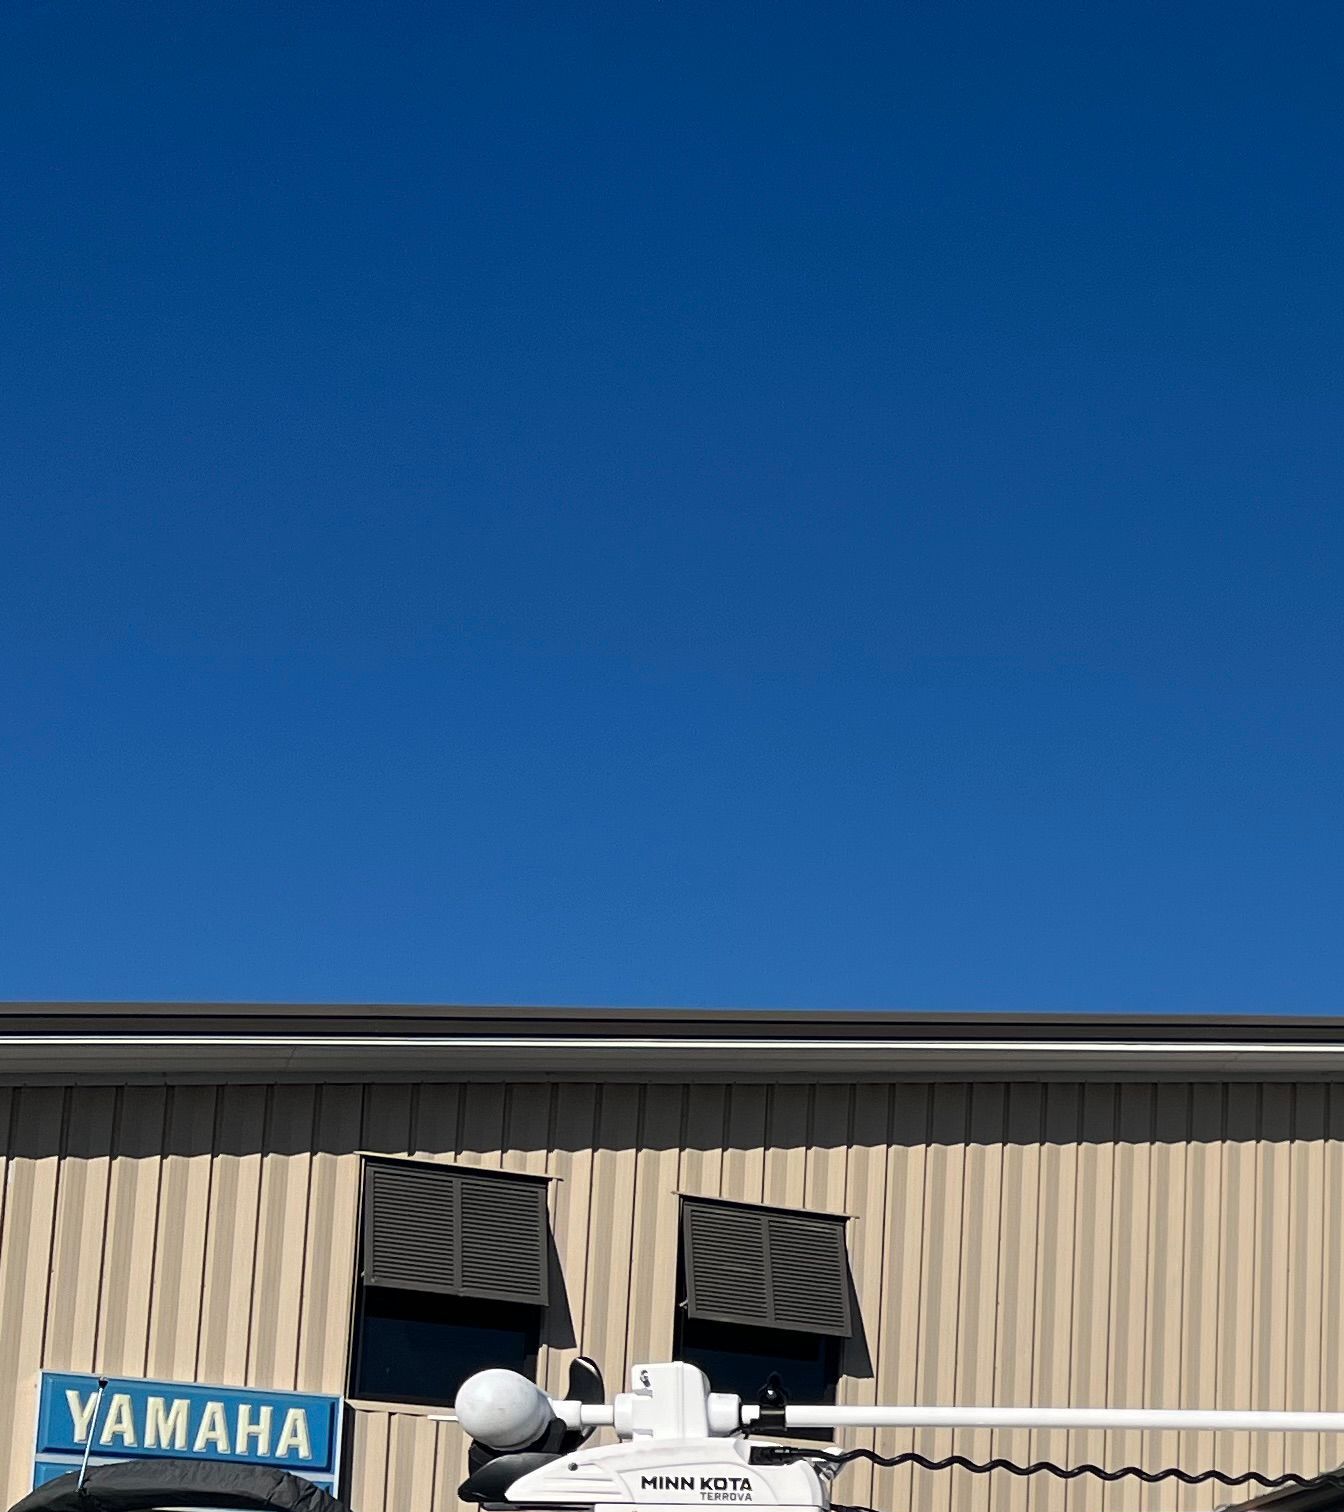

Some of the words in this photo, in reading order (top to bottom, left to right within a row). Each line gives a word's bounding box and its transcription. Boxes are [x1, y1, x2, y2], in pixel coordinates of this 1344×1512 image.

[65, 1389, 313, 1460] YAMAHA
[641, 1475, 695, 1491] MINN
[700, 1477, 753, 1492] KOTA
[700, 1491, 753, 1502] TERROVA
